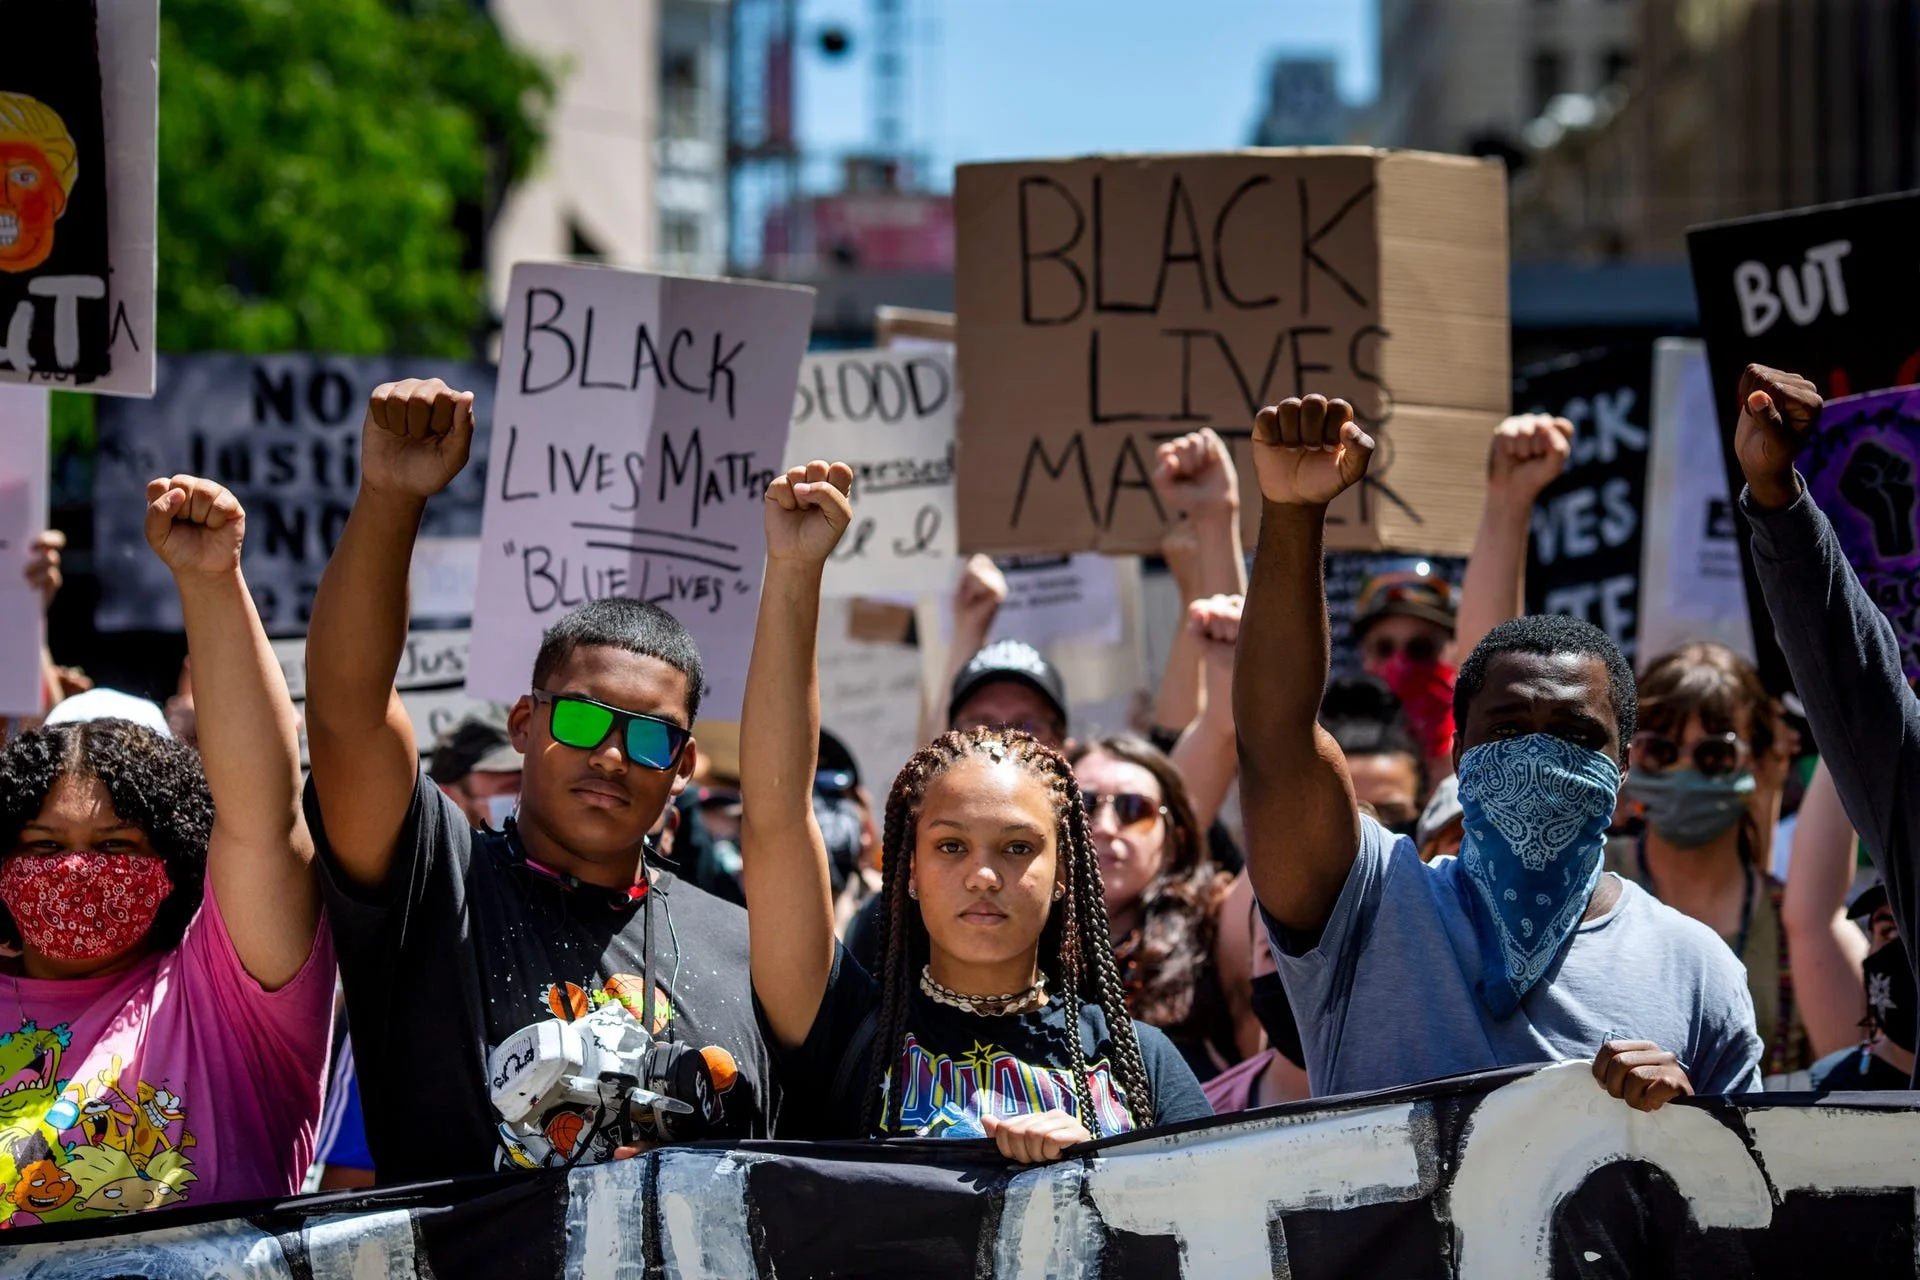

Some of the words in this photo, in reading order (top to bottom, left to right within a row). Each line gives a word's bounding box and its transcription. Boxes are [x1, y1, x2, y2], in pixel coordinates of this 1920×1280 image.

[1018, 173, 1378, 327] BLACK
[1733, 239, 1853, 338] BUT
[252, 364, 356, 425] NO
[519, 287, 746, 419] BLACK
[1089, 325, 1394, 426] LIVES
[501, 425, 646, 512] LIVES
[657, 427, 775, 529] MATTER
[1556, 385, 1649, 471] CK
